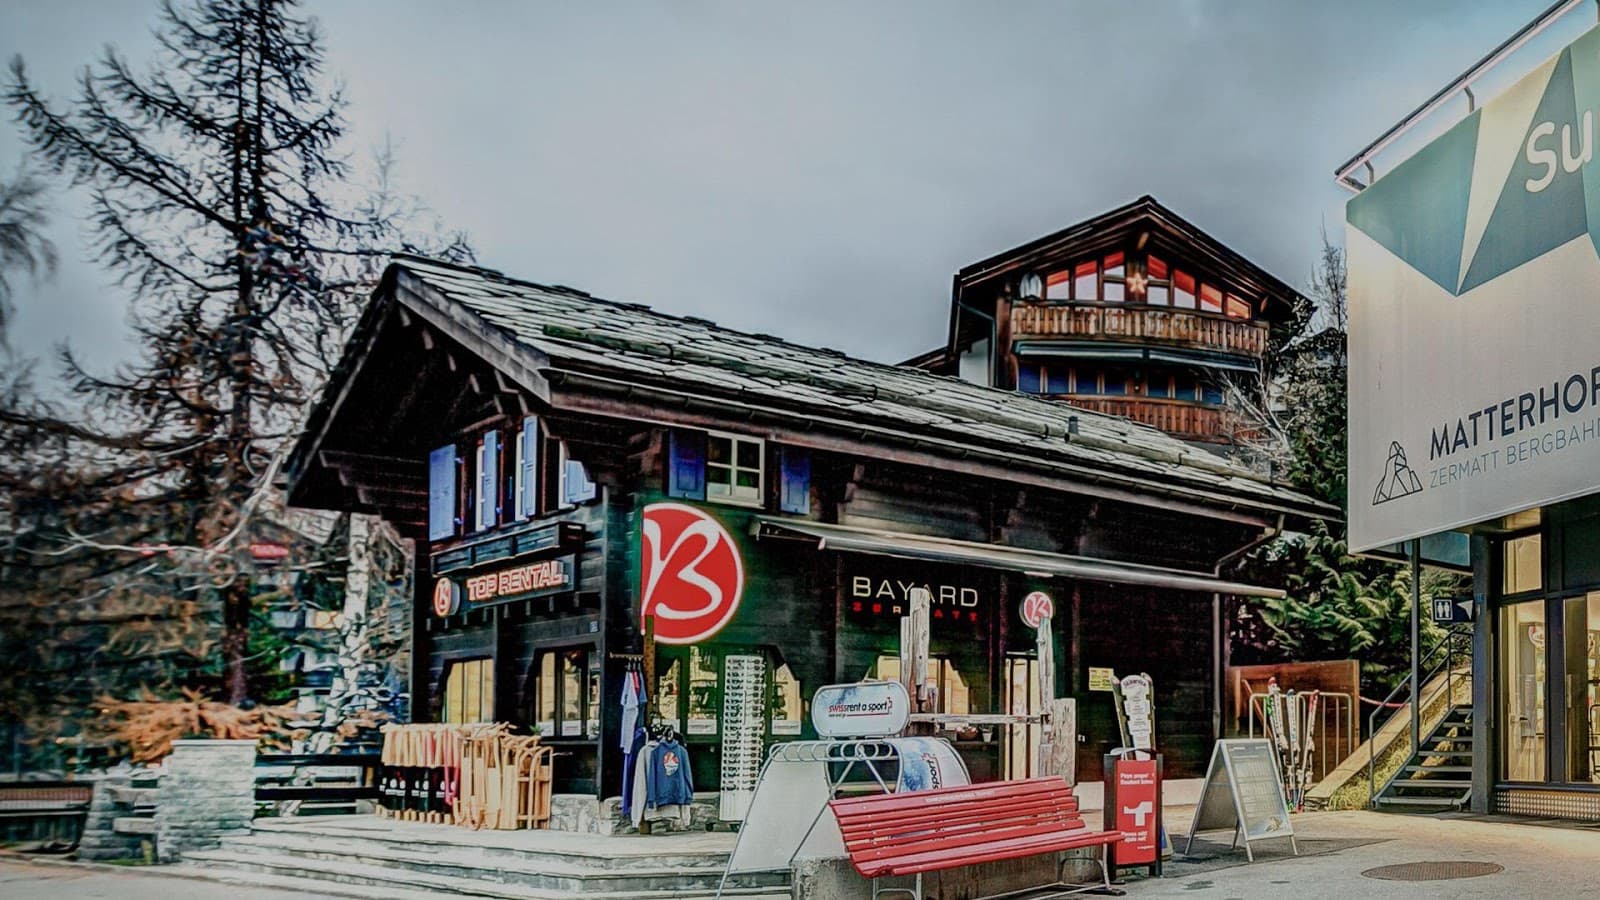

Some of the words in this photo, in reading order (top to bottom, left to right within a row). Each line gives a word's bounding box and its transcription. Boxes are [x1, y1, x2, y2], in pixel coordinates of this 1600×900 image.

[1430, 450, 1499, 489] ZERMATT
[1507, 417, 1600, 465] BERGBAH
[467, 574, 498, 601] TOP
[498, 560, 564, 595] RENTAL
[852, 601, 978, 622] ZERATT
[868, 701, 887, 713] sport
[926, 759, 939, 790] sport
